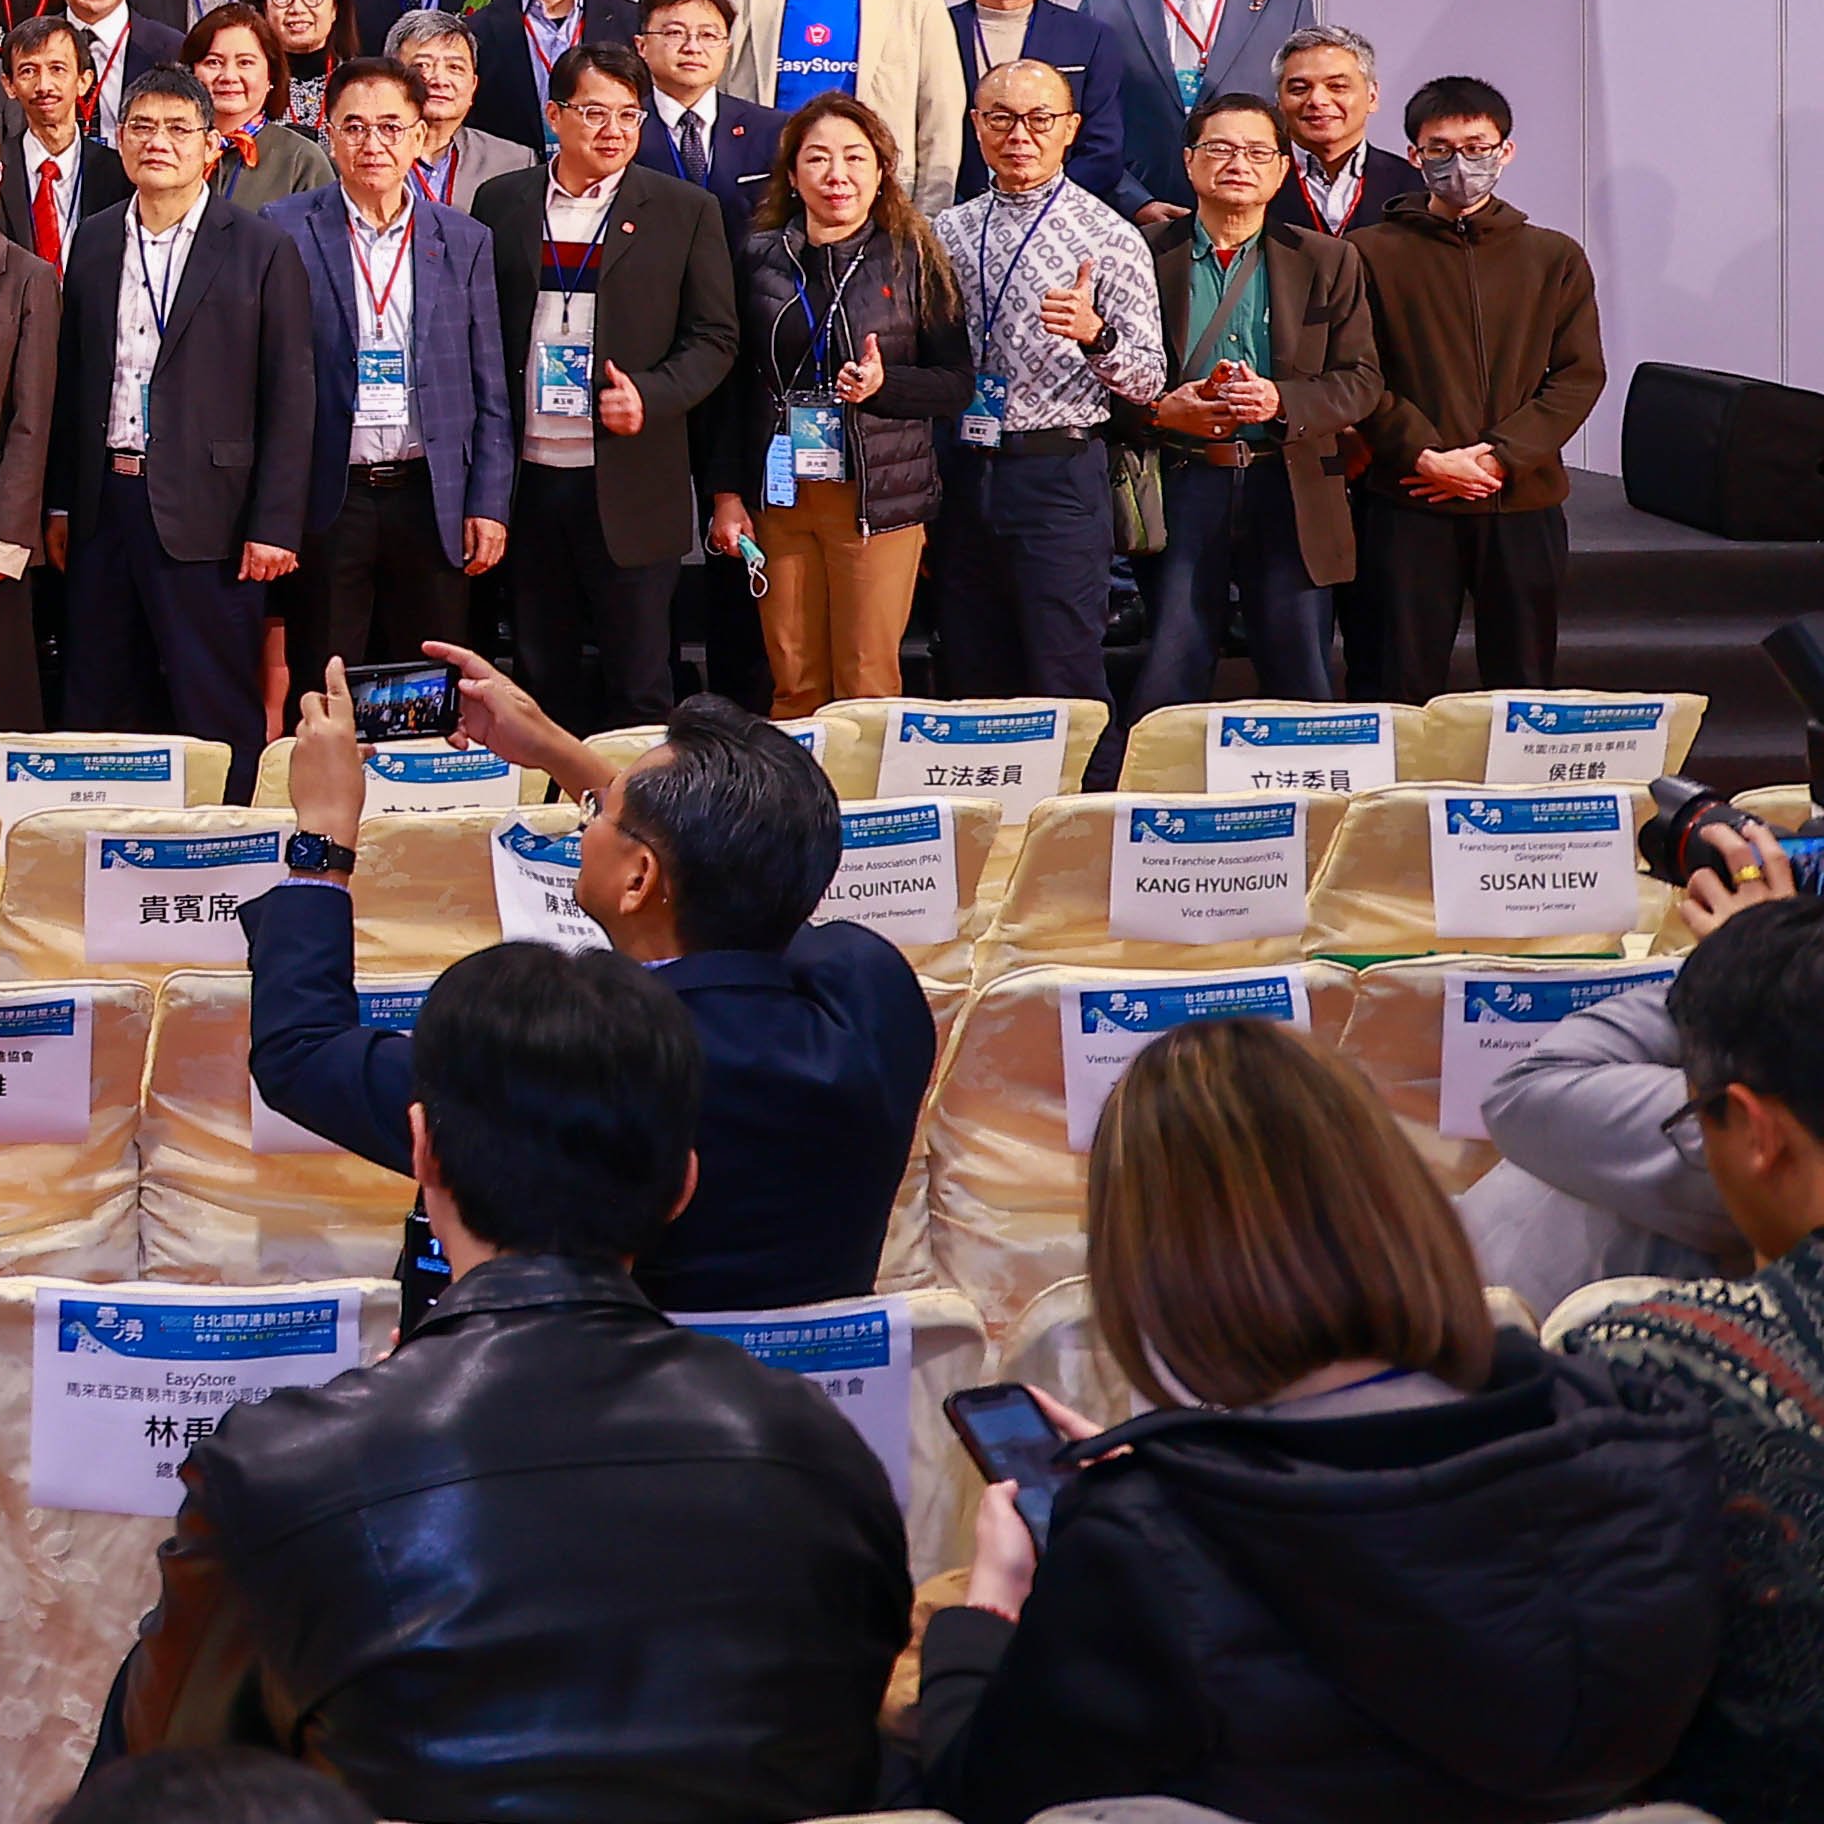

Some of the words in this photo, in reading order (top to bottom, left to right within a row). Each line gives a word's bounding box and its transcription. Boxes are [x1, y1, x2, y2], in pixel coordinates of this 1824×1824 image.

[776, 58, 858, 75] EasyStore
[924, 764, 1022, 786] 立法委員
[70, 791, 106, 802] 總統府
[1459, 842, 1507, 853] Franchising
[1509, 842, 1525, 851] and
[1568, 839, 1612, 849] Association
[866, 857, 917, 871] Association
[920, 853, 942, 865] (PFA)
[1143, 857, 1170, 866] Korea
[1173, 856, 1215, 865] Franchise
[849, 877, 936, 898] QUINTANA
[1136, 876, 1190, 893] KANG
[1195, 873, 1288, 892] HYUNGJUN
[1480, 873, 1546, 890] SUSAN
[1553, 872, 1598, 889] LIEW
[140, 893, 239, 923] 貴賓席
[1182, 907, 1203, 917] Vice
[1206, 906, 1249, 916] chairman
[193, 1310, 332, 1329] 台北國際連鎖加盟大展
[166, 1372, 236, 1387] EasyStore
